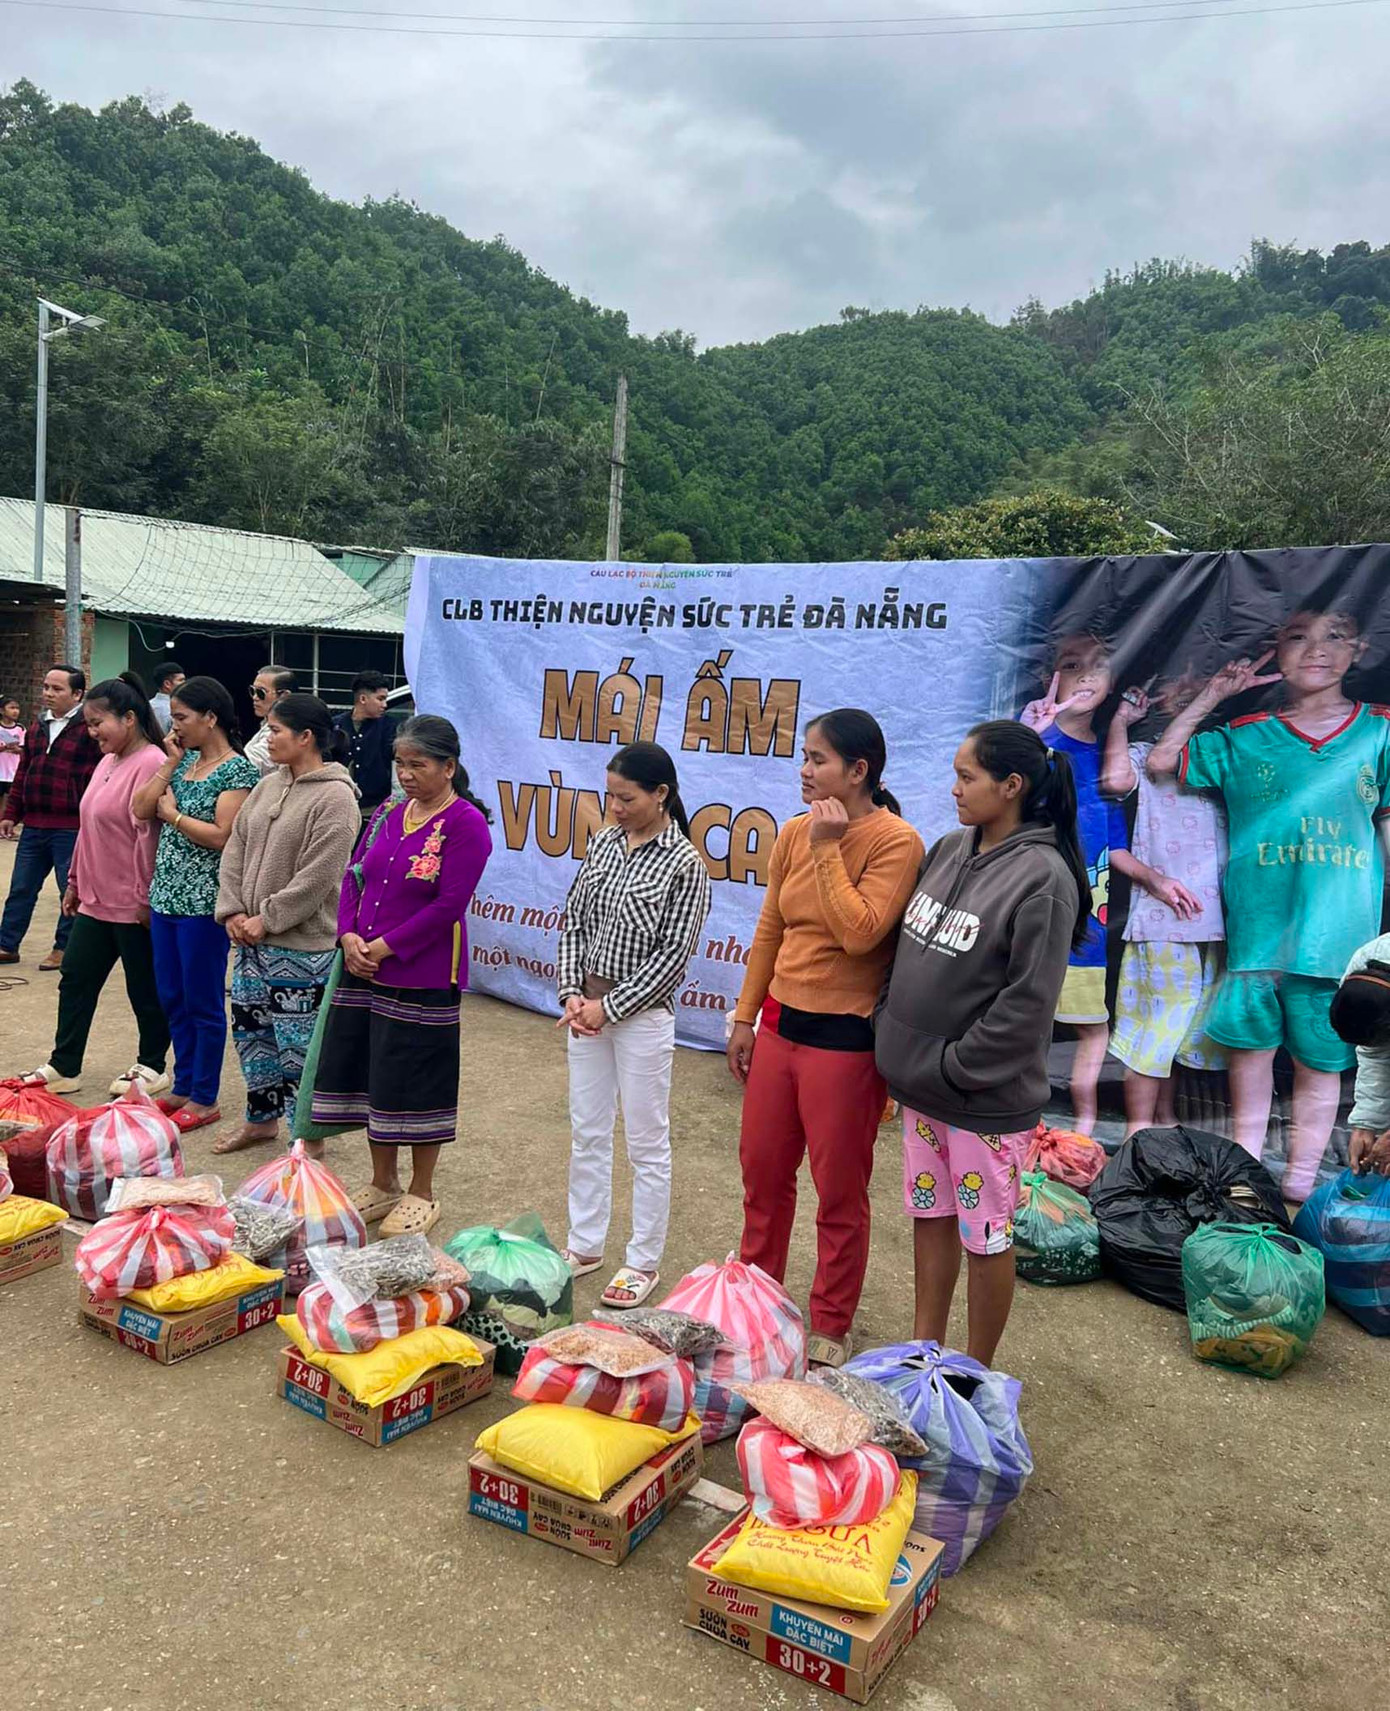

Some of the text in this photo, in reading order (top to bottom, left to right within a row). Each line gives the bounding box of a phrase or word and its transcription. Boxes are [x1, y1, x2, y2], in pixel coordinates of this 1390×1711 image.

[442, 587, 947, 634] CLB THIỆN NGUYỆN SỨC TRẺ ĐÀ NẴNG
[539, 650, 801, 758] MÁI ẤM
[497, 770, 800, 887] VÙN CA
[1301, 815, 1341, 840] Fly
[471, 892, 515, 923] hêm
[473, 945, 558, 981] một ngọ
[680, 980, 726, 1010] ấm
[245, 1302, 274, 1328] 30+2
[294, 1361, 324, 1392] 30+2
[391, 1387, 426, 1418] 30+2
[480, 1472, 518, 1504] 30+2
[633, 1480, 660, 1522] 30+2
[706, 1579, 739, 1600] Zum
[779, 1609, 822, 1637] KHUYẾN
[729, 1633, 751, 1651] CAY
[785, 1626, 835, 1654] ĐẶC BIỆT
[779, 1644, 831, 1687] 30+2
